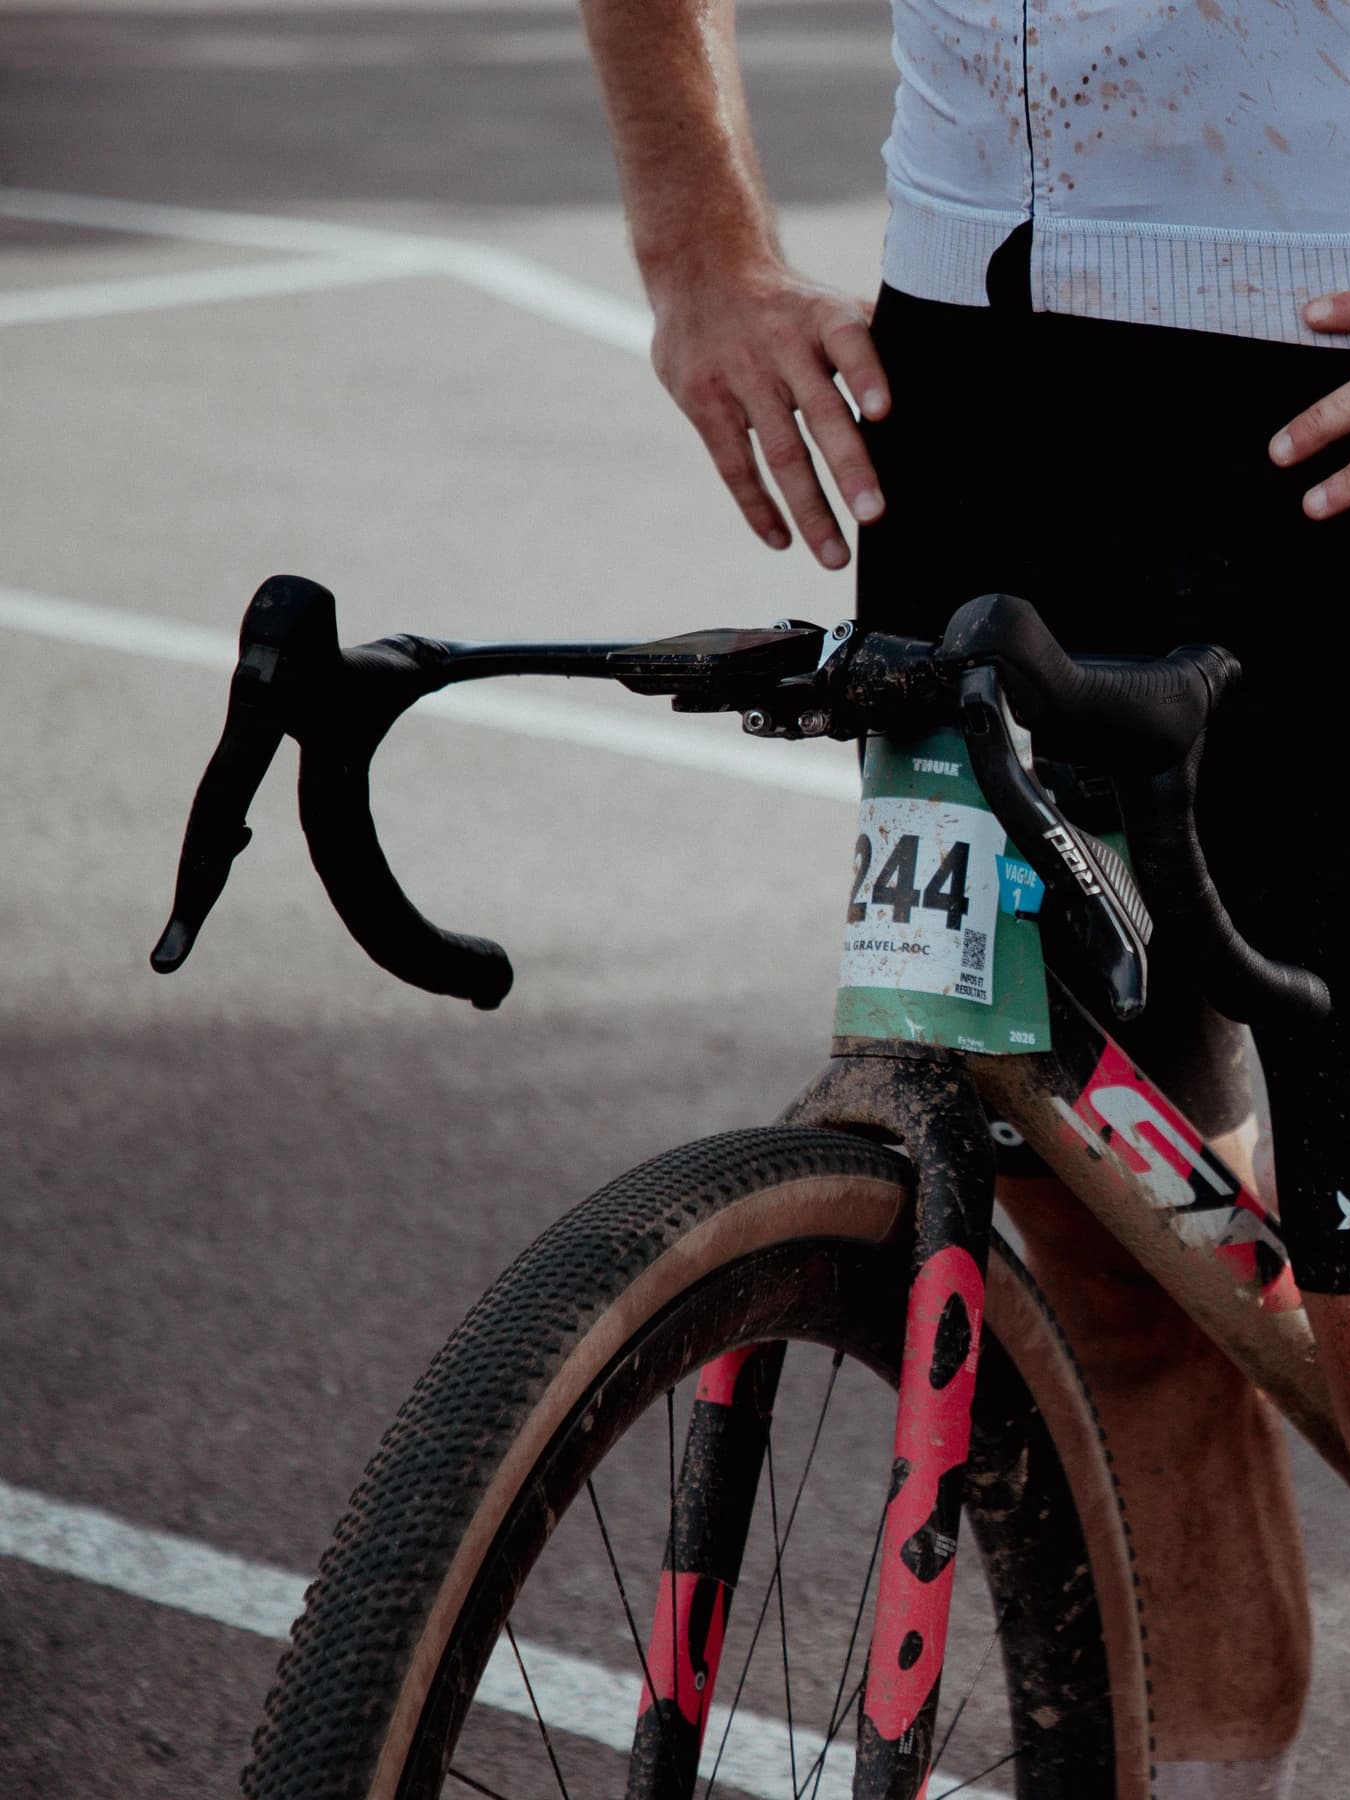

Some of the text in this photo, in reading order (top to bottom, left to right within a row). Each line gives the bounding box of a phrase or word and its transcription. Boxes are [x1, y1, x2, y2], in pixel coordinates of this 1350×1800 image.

[912, 757, 960, 777] THULE
[847, 833, 971, 932] 244
[1005, 862, 1037, 889] VAGUE
[1012, 888, 1022, 911] 1
[852, 939, 931, 956] GRAVEL-ROC
[1009, 1029, 1036, 1046] 2026
